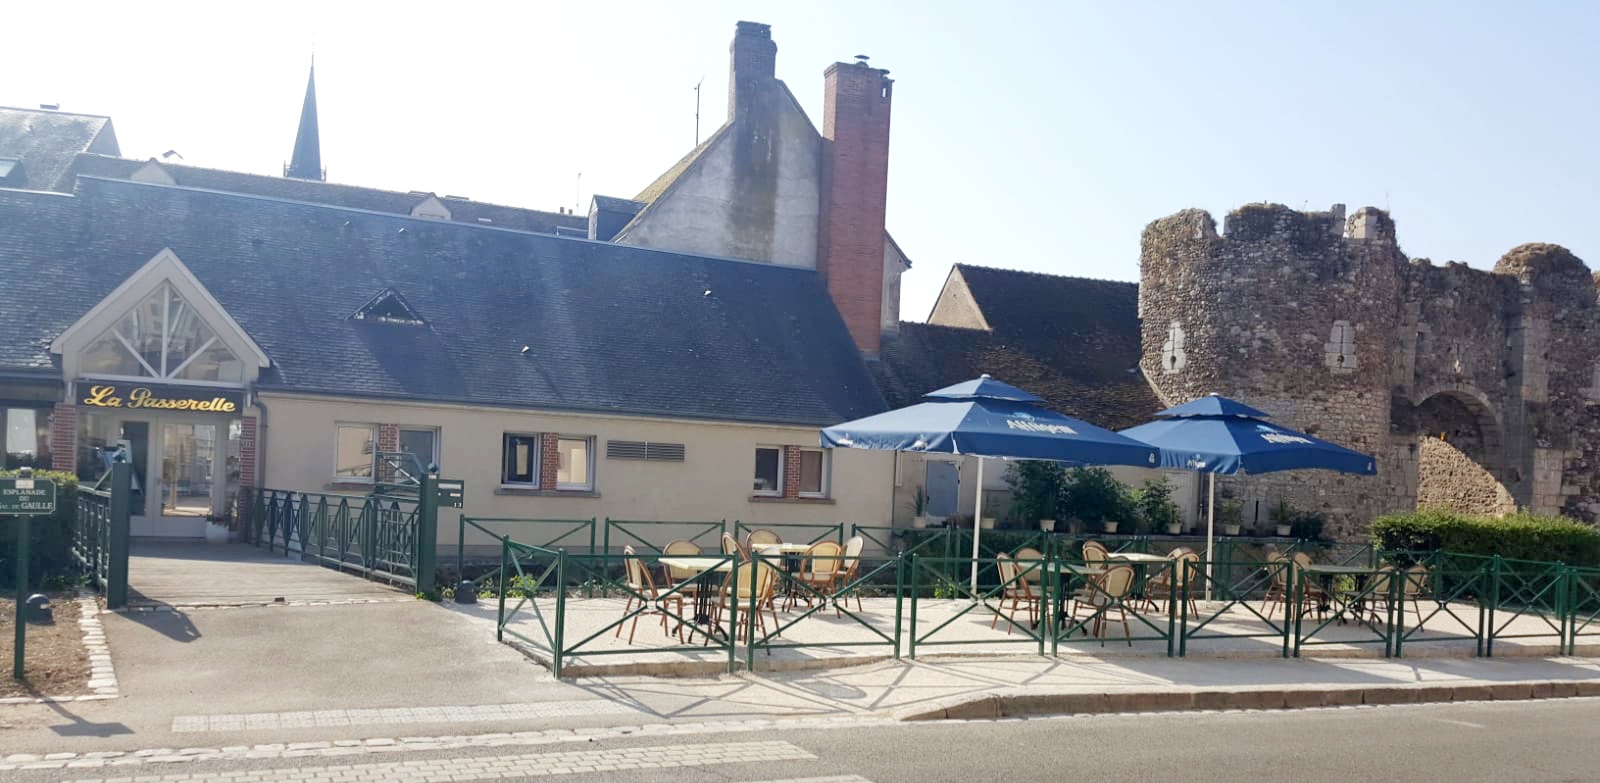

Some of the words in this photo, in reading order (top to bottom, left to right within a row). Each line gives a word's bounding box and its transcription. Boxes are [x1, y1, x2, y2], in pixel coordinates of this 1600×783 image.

[85, 385, 123, 407] La
[127, 387, 236, 412] Passerelle
[20, 502, 53, 510] GAULLE
